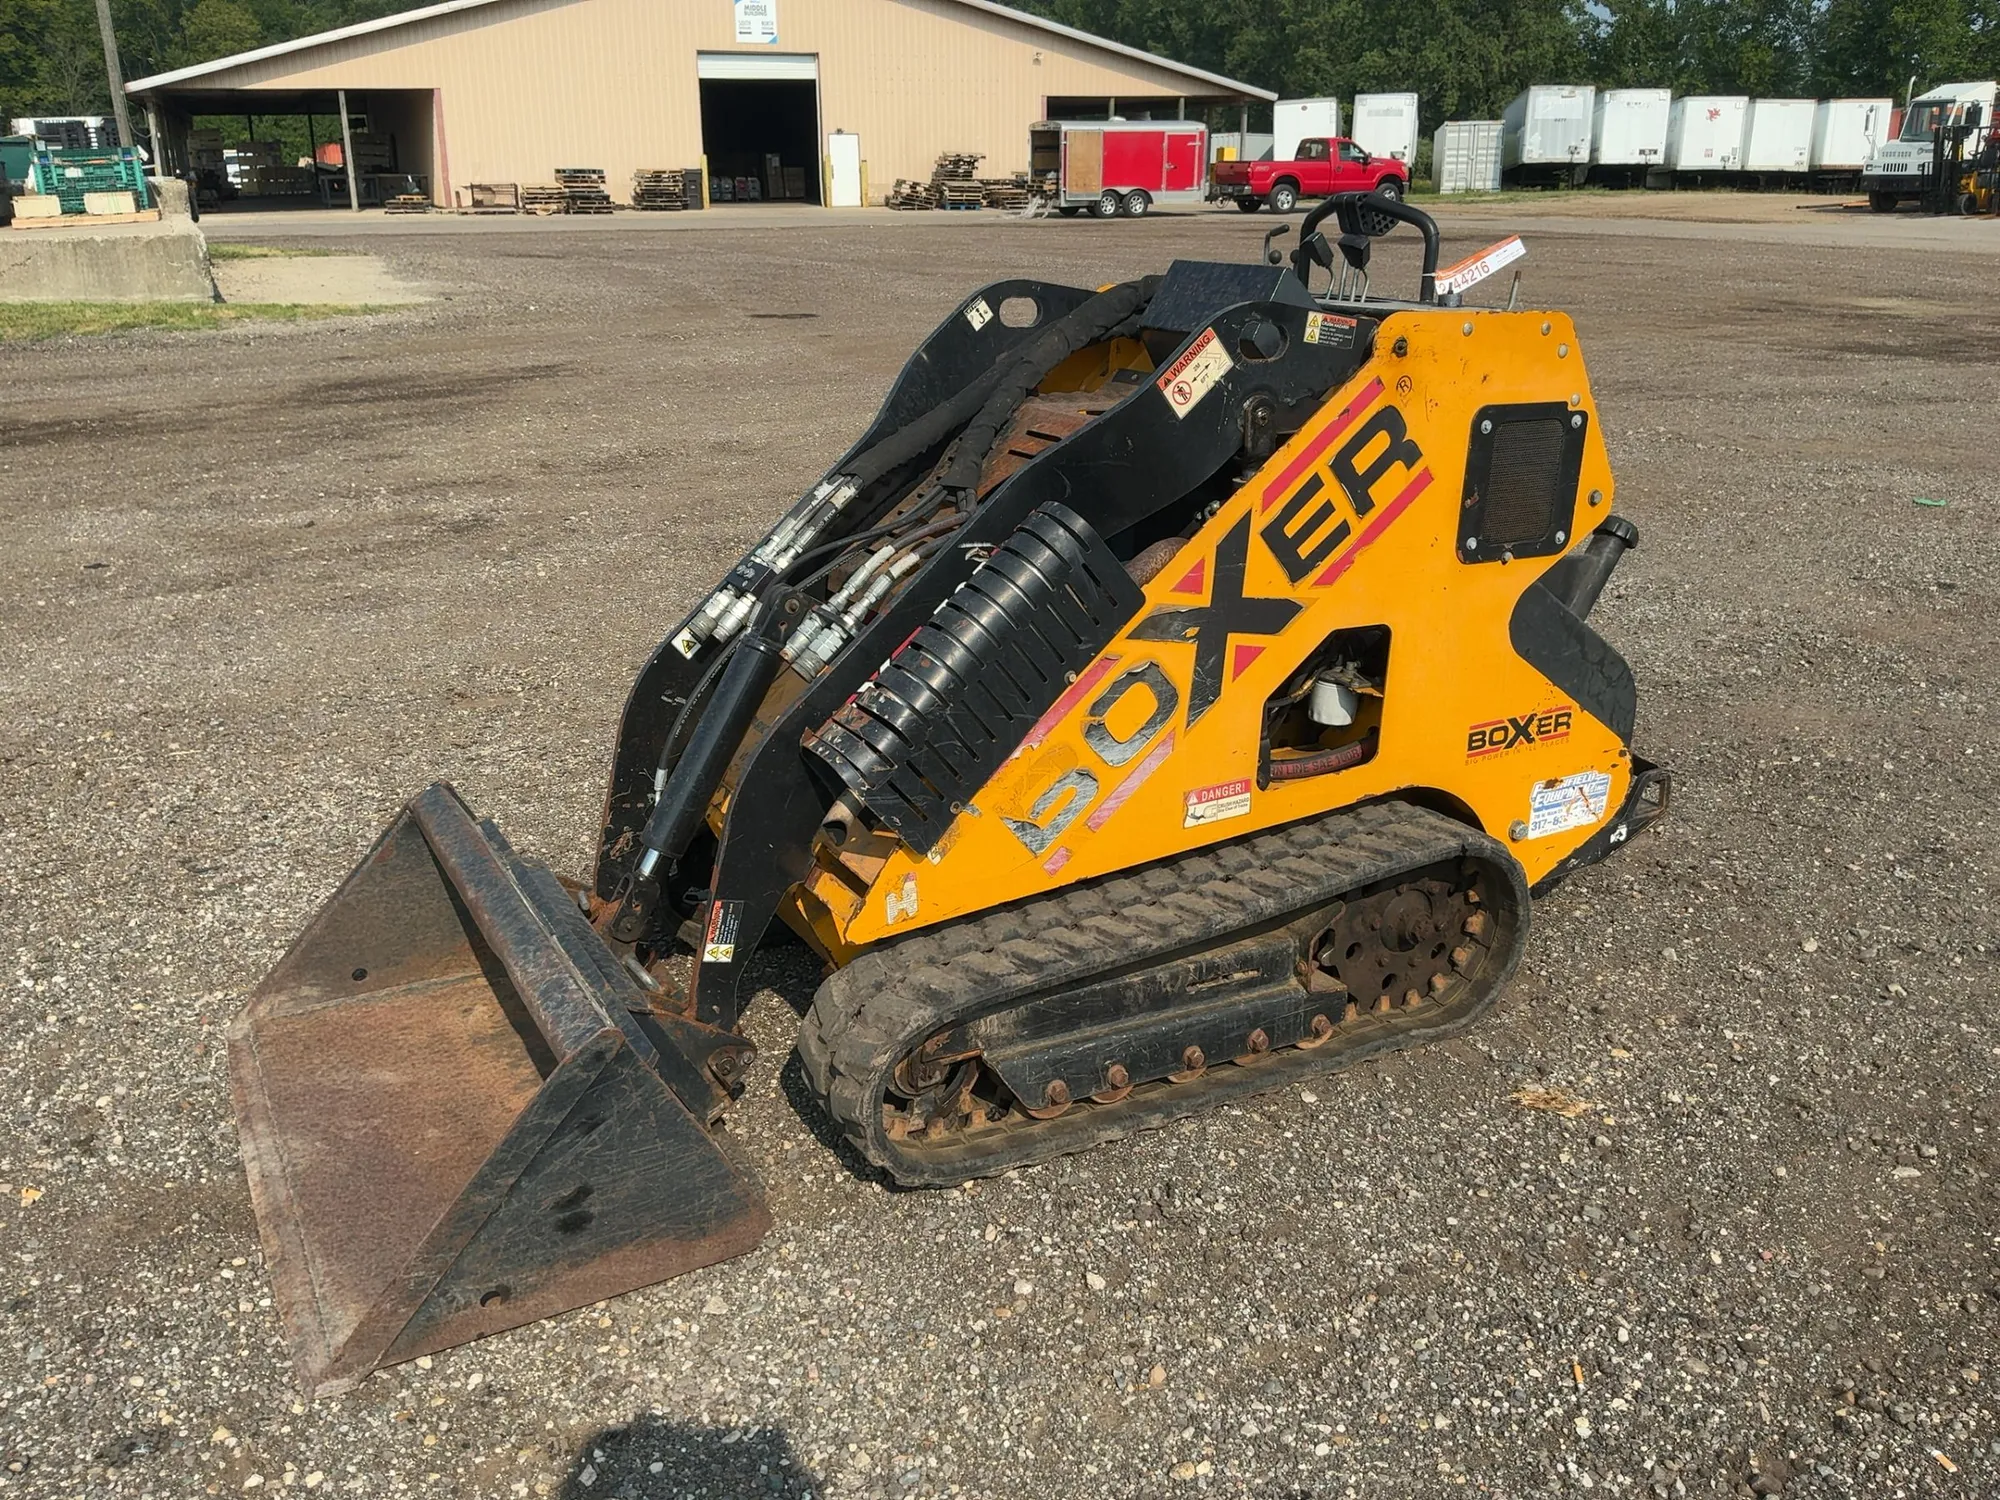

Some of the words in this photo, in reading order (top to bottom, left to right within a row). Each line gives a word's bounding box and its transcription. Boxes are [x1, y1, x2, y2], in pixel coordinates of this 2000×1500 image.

[1171, 334, 1211, 377] WARNING
[1467, 712, 1572, 752] BOXER
[1464, 757, 1479, 766] BIG
[1481, 750, 1510, 762] POWER
[1540, 737, 1570, 749] PLACES
[1286, 764, 1310, 775] LINE
[1312, 760, 1334, 771] SAE
[1201, 781, 1246, 802] DANGER!
